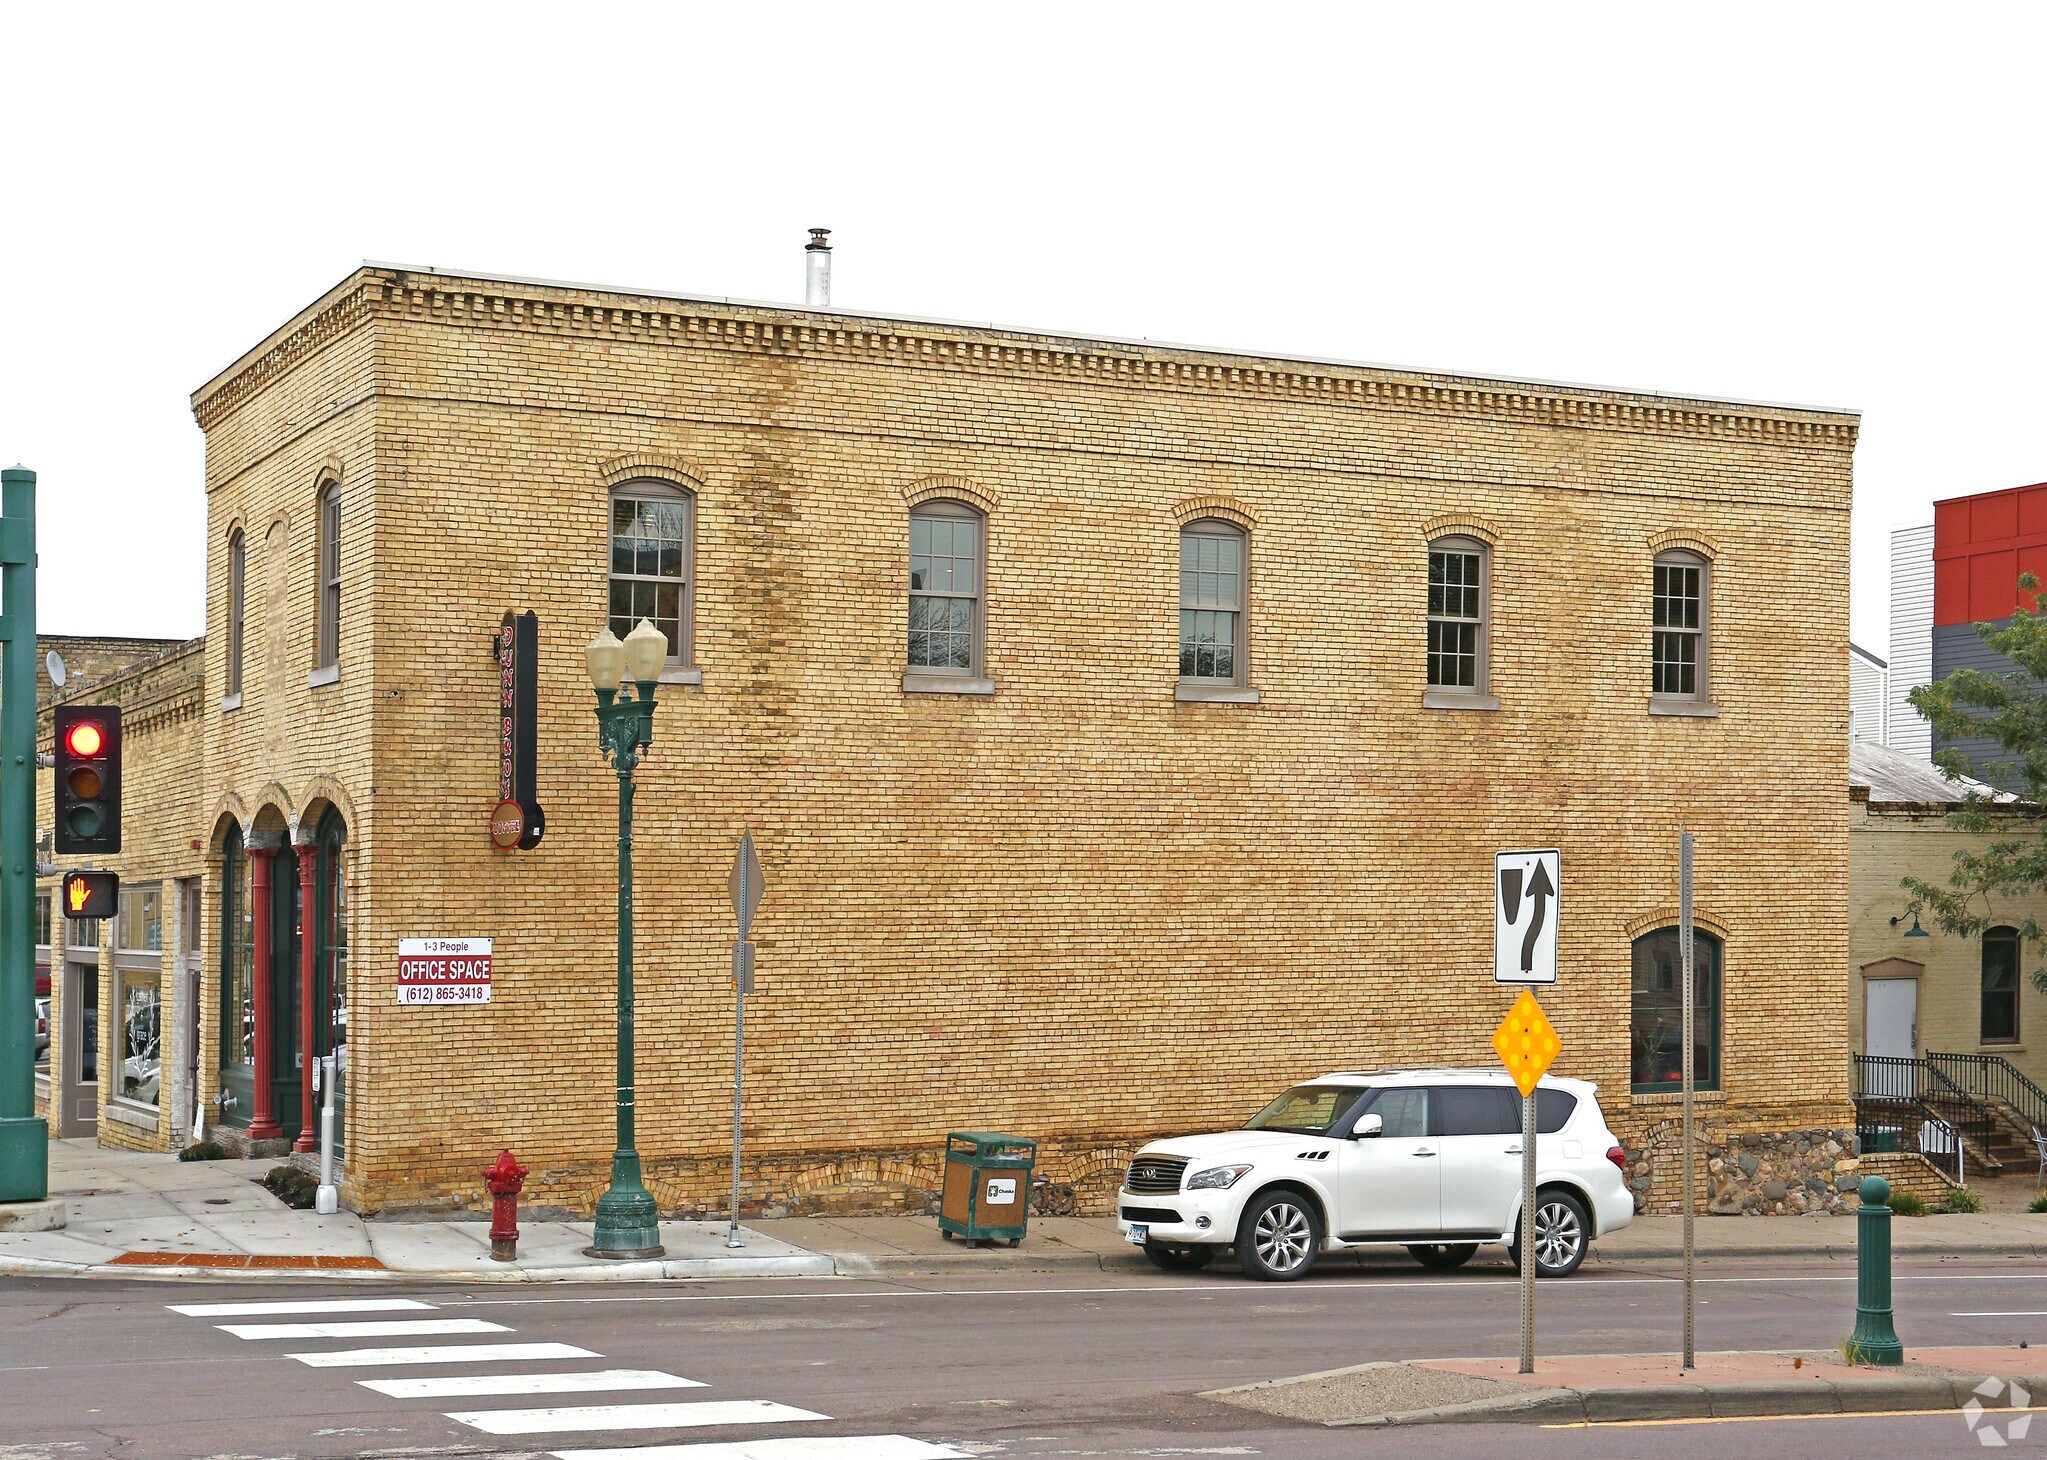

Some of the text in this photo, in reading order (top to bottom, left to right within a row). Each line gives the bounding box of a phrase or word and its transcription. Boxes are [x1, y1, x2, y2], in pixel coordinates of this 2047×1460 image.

[500, 626, 514, 800] DUNN BROS
[424, 942, 469, 953] 1-3 People
[401, 959, 490, 980] OFFICE SPACE
[406, 986, 483, 1003] (612) 865-3418
